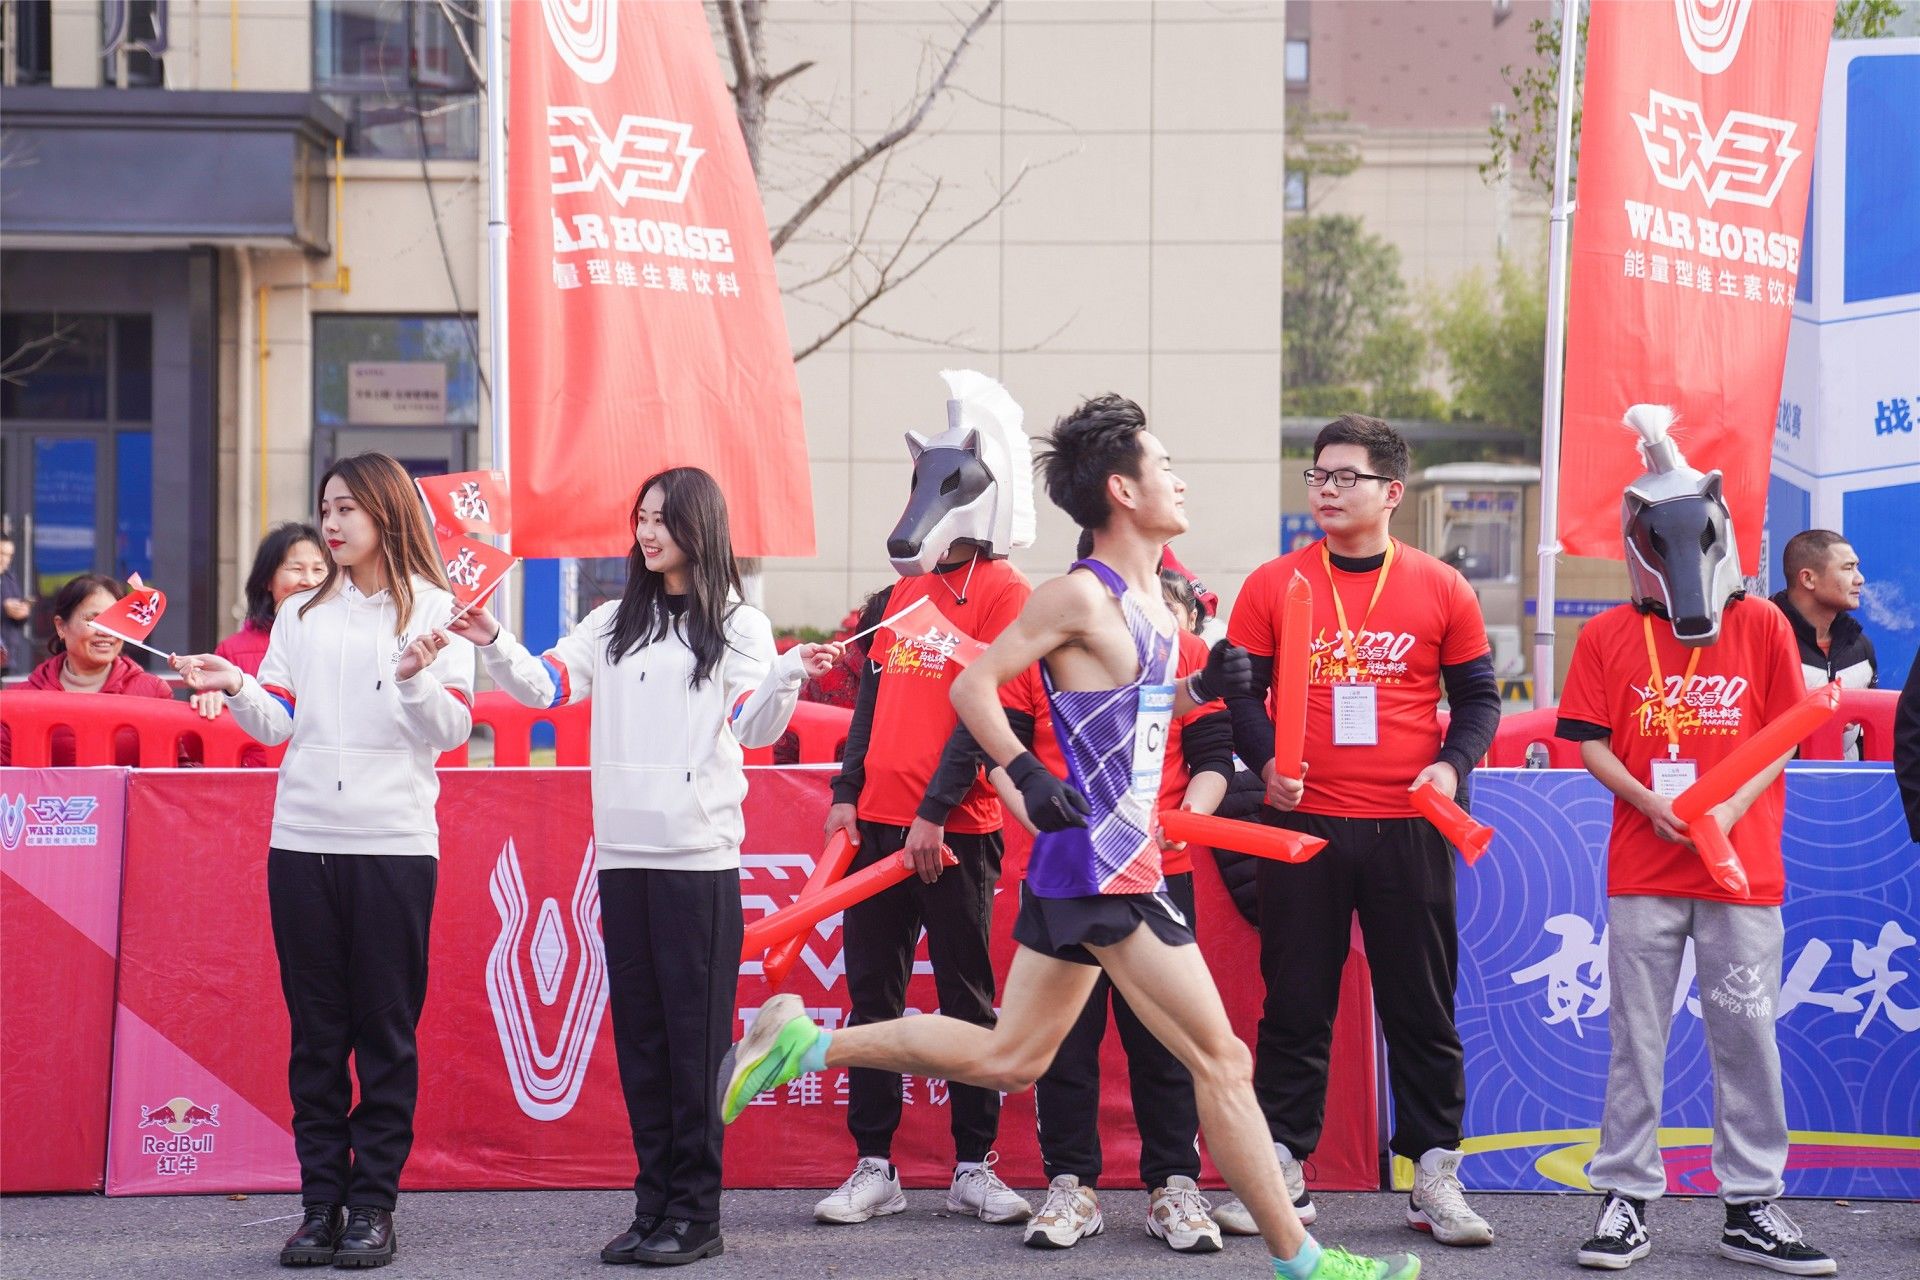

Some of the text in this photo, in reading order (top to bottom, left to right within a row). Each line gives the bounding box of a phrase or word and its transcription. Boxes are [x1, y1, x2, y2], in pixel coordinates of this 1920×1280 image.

[551, 207, 735, 263] AR HORSE
[1624, 199, 1800, 276] WAR HORSE
[552, 256, 741, 298] 量型维生素饮料
[1875, 397, 1920, 436] 战
[1315, 674, 1401, 685] XIANJIANG
[1645, 727, 1739, 737] XIAGJIANG
[27, 825, 97, 836] WAR HORSE
[1510, 913, 1920, 1039] 敢人先
[142, 1134, 215, 1154] RedBull
[157, 1155, 198, 1175] 红牛
